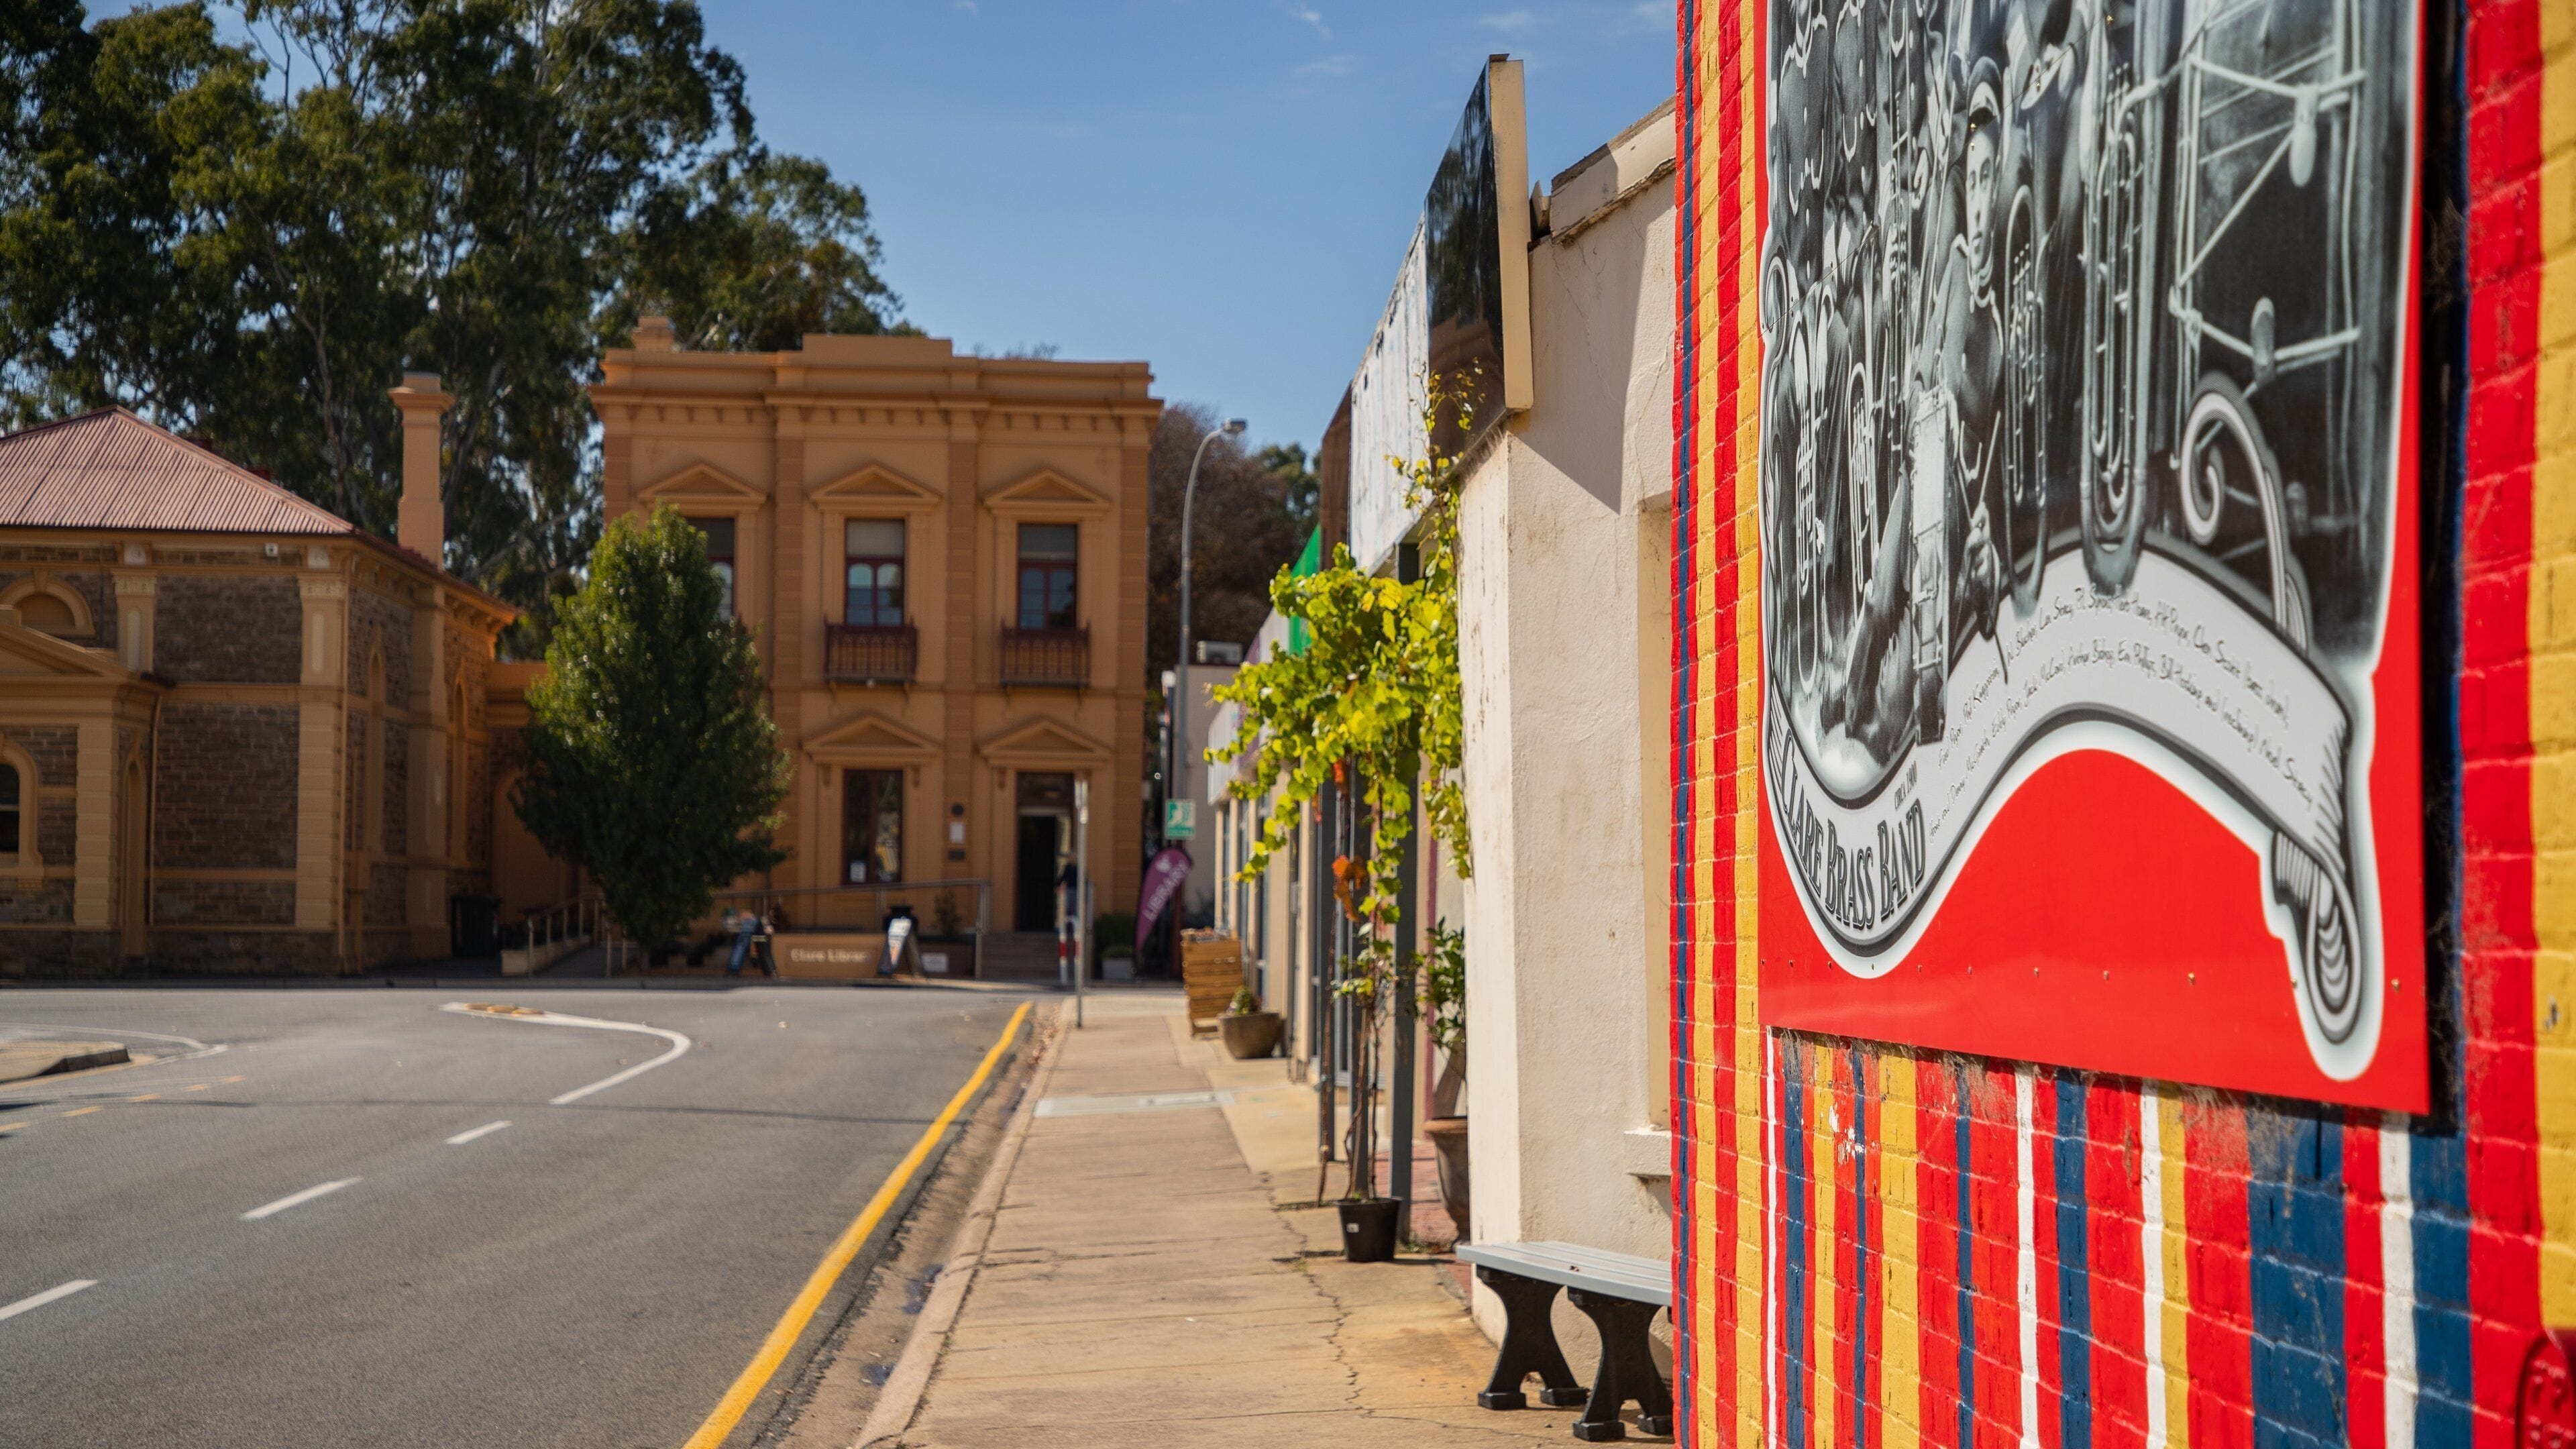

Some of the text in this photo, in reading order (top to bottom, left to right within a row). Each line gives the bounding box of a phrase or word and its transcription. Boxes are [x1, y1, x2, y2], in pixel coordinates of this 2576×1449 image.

[1782, 727, 1926, 930] CLARE BRASS BAND
[790, 948, 870, 963] Clare Librar
